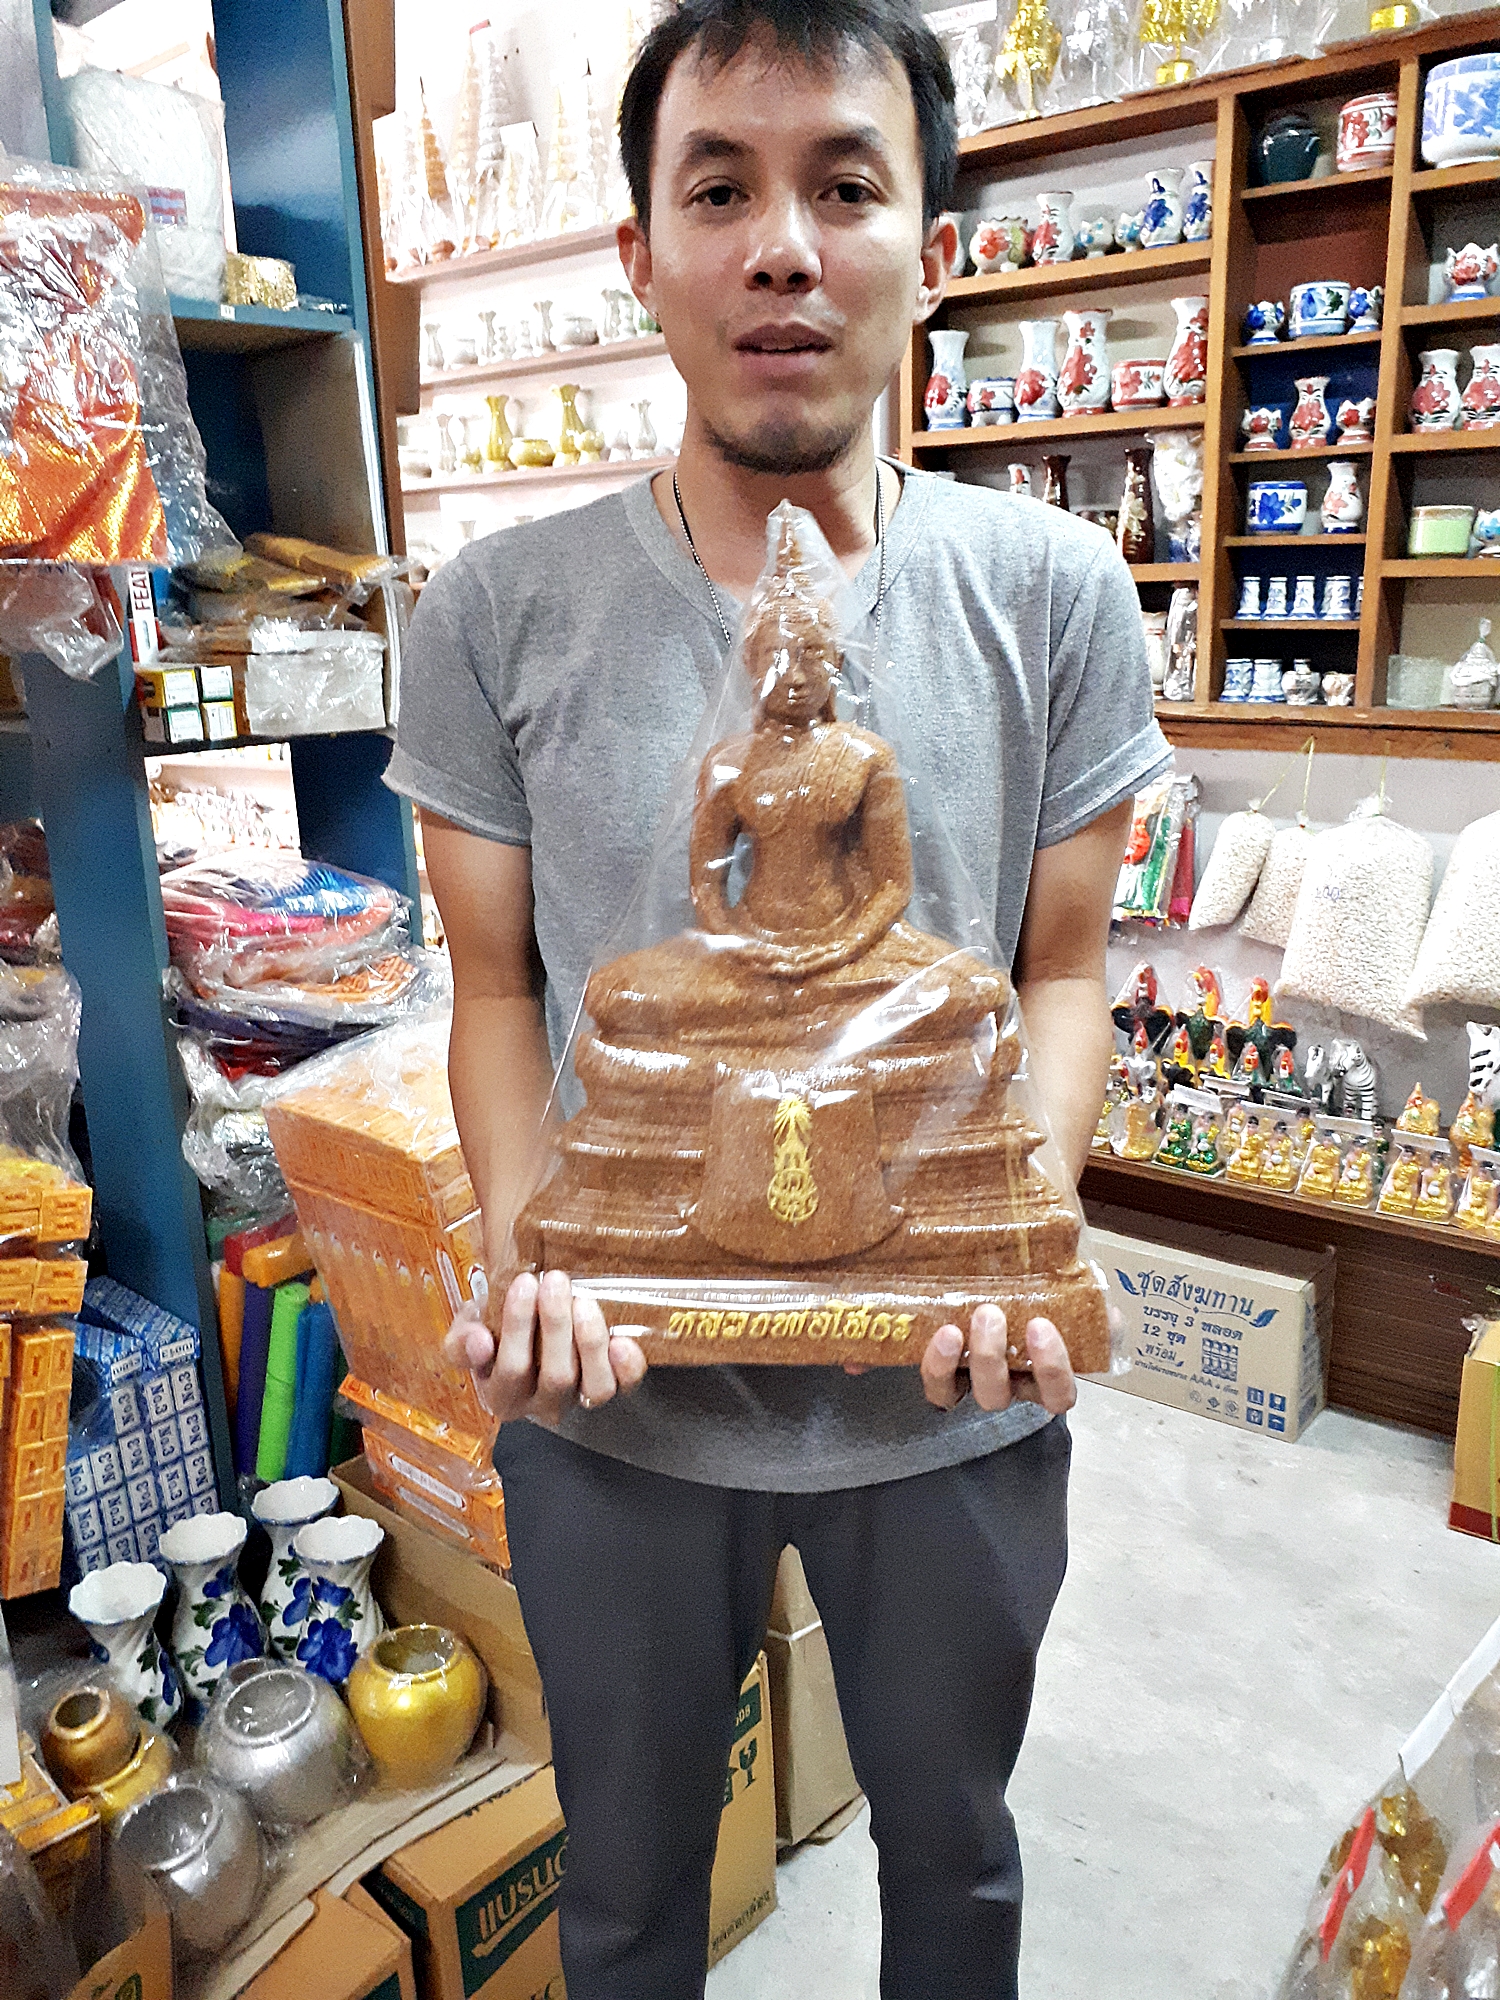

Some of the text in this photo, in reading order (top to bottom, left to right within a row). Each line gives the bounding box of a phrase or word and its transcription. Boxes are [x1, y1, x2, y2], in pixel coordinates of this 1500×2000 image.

[1138, 1270, 1254, 1317] ชุดสังฆทาน
[1142, 1323, 1187, 1346] 12 ชุด
[1143, 1305, 1244, 1341] บรรจุ 3 หลอด
[1145, 1343, 1178, 1362] พร้อม
[178, 1370, 196, 1405] No.3
[1189, 1374, 1213, 1388] AAA
[118, 1392, 135, 1426] No.3
[151, 1383, 168, 1415] No.3
[159, 1424, 175, 1457] No.3
[186, 1414, 202, 1446] No.3
[98, 1452, 116, 1485] No.3
[127, 1437, 144, 1470] No.3
[166, 1470, 183, 1501] No.3
[193, 1456, 209, 1488] No.3
[108, 1495, 125, 1527] No.3
[136, 1480, 153, 1513] No.3
[77, 1508, 95, 1541] No.3
